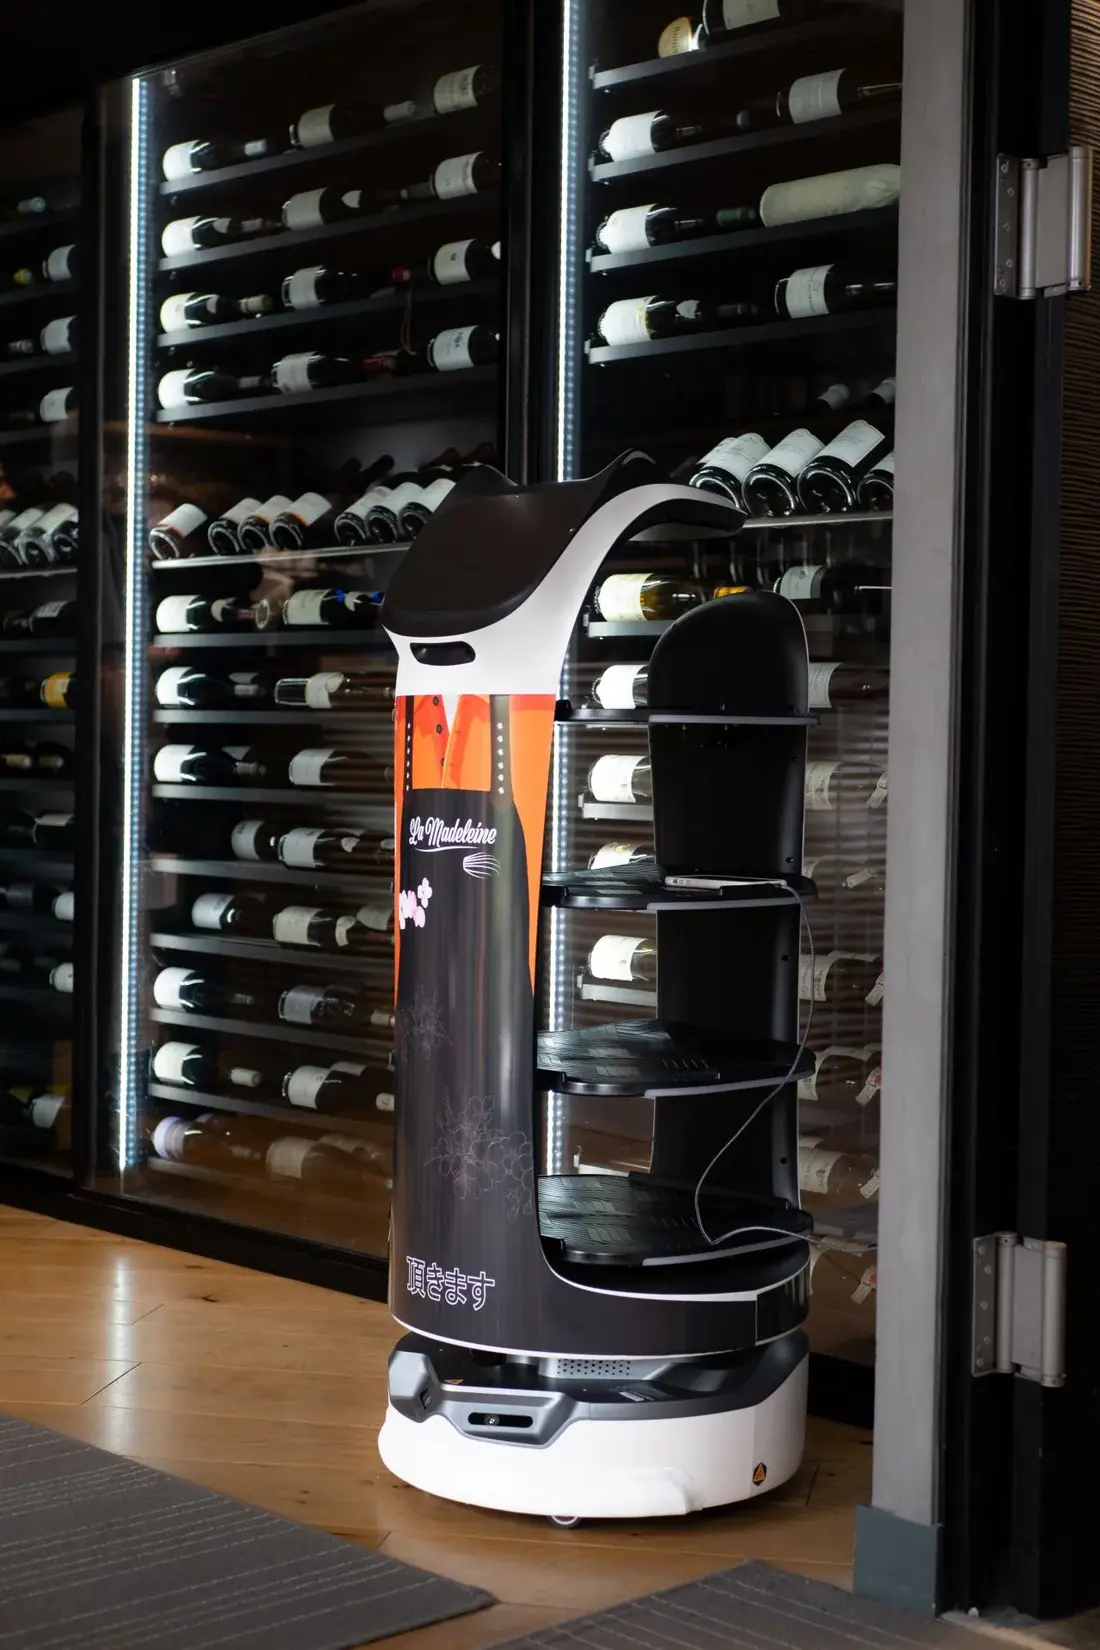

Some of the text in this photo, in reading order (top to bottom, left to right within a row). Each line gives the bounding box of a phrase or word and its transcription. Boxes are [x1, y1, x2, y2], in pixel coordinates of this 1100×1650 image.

[408, 816, 497, 848] La Madeleine
[406, 1255, 496, 1311] 頂きます
